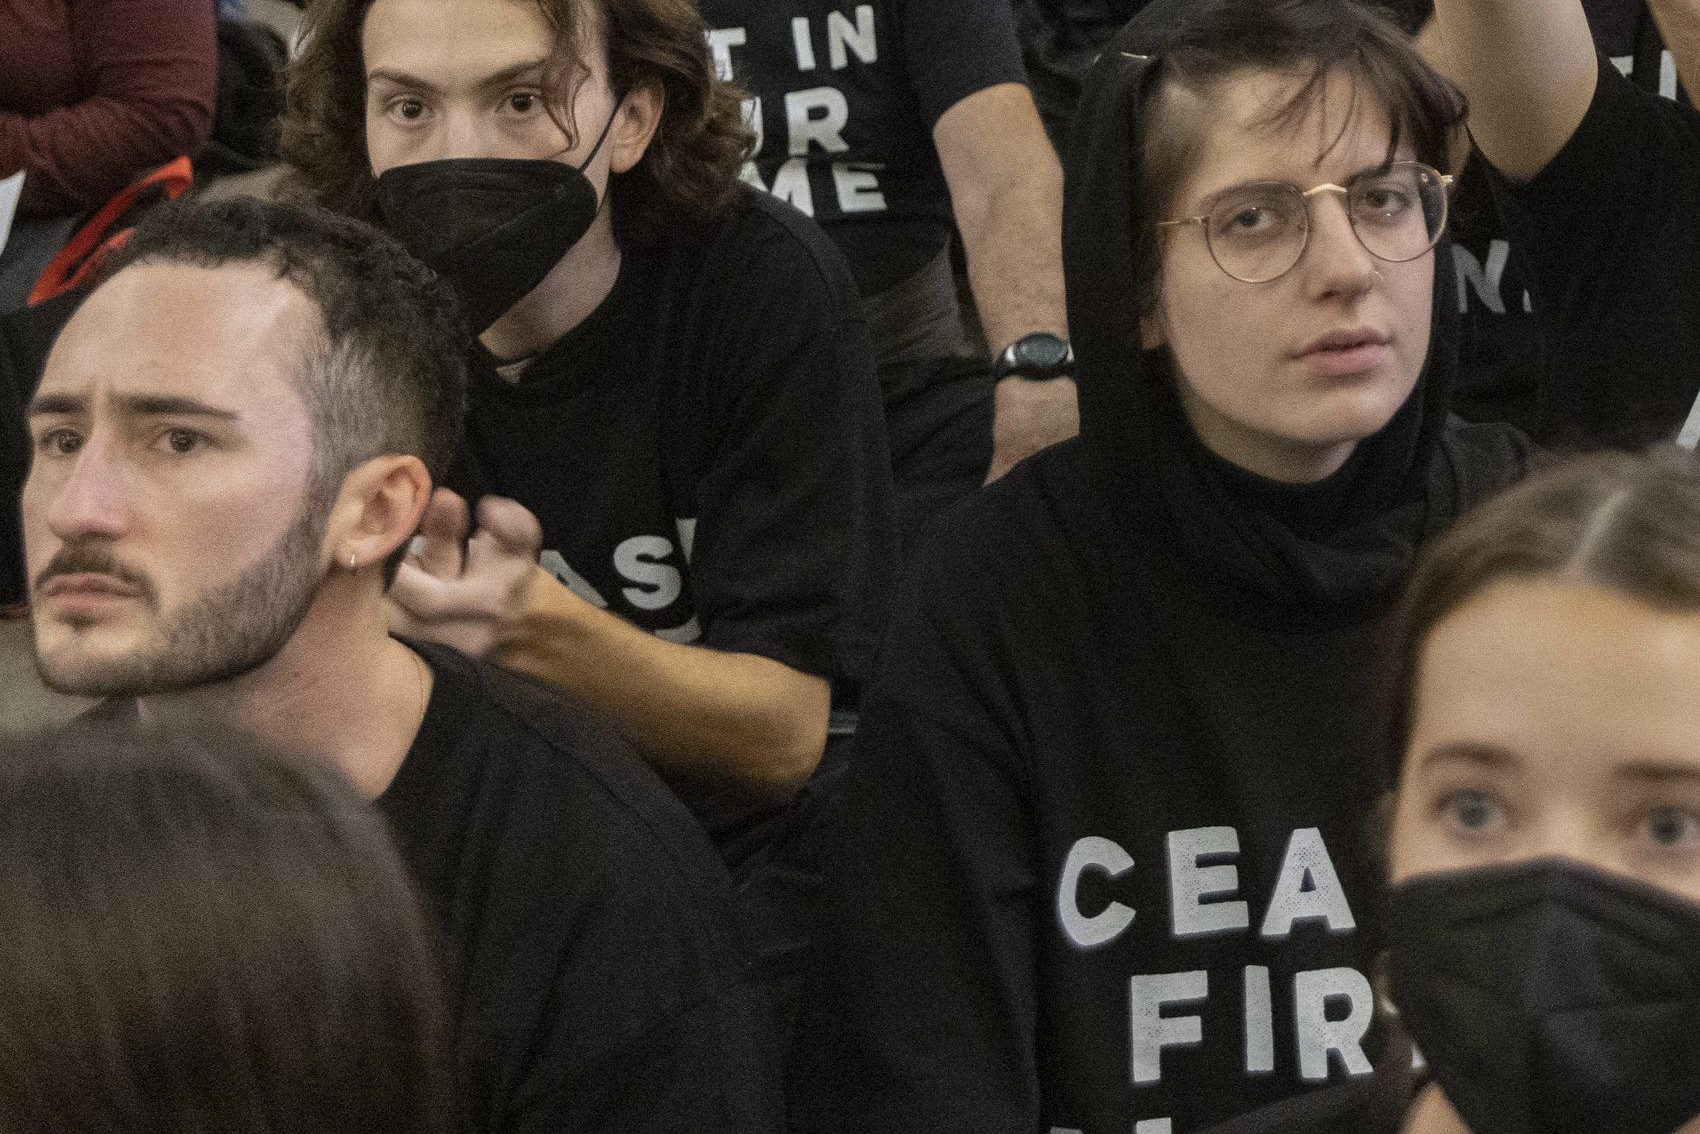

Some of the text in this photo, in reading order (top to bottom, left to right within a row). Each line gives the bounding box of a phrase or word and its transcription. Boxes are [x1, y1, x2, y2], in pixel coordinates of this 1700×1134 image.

[791, 4, 877, 70] IN
[1058, 825, 1357, 947] CEA
[1131, 964, 1374, 1084] FIR
